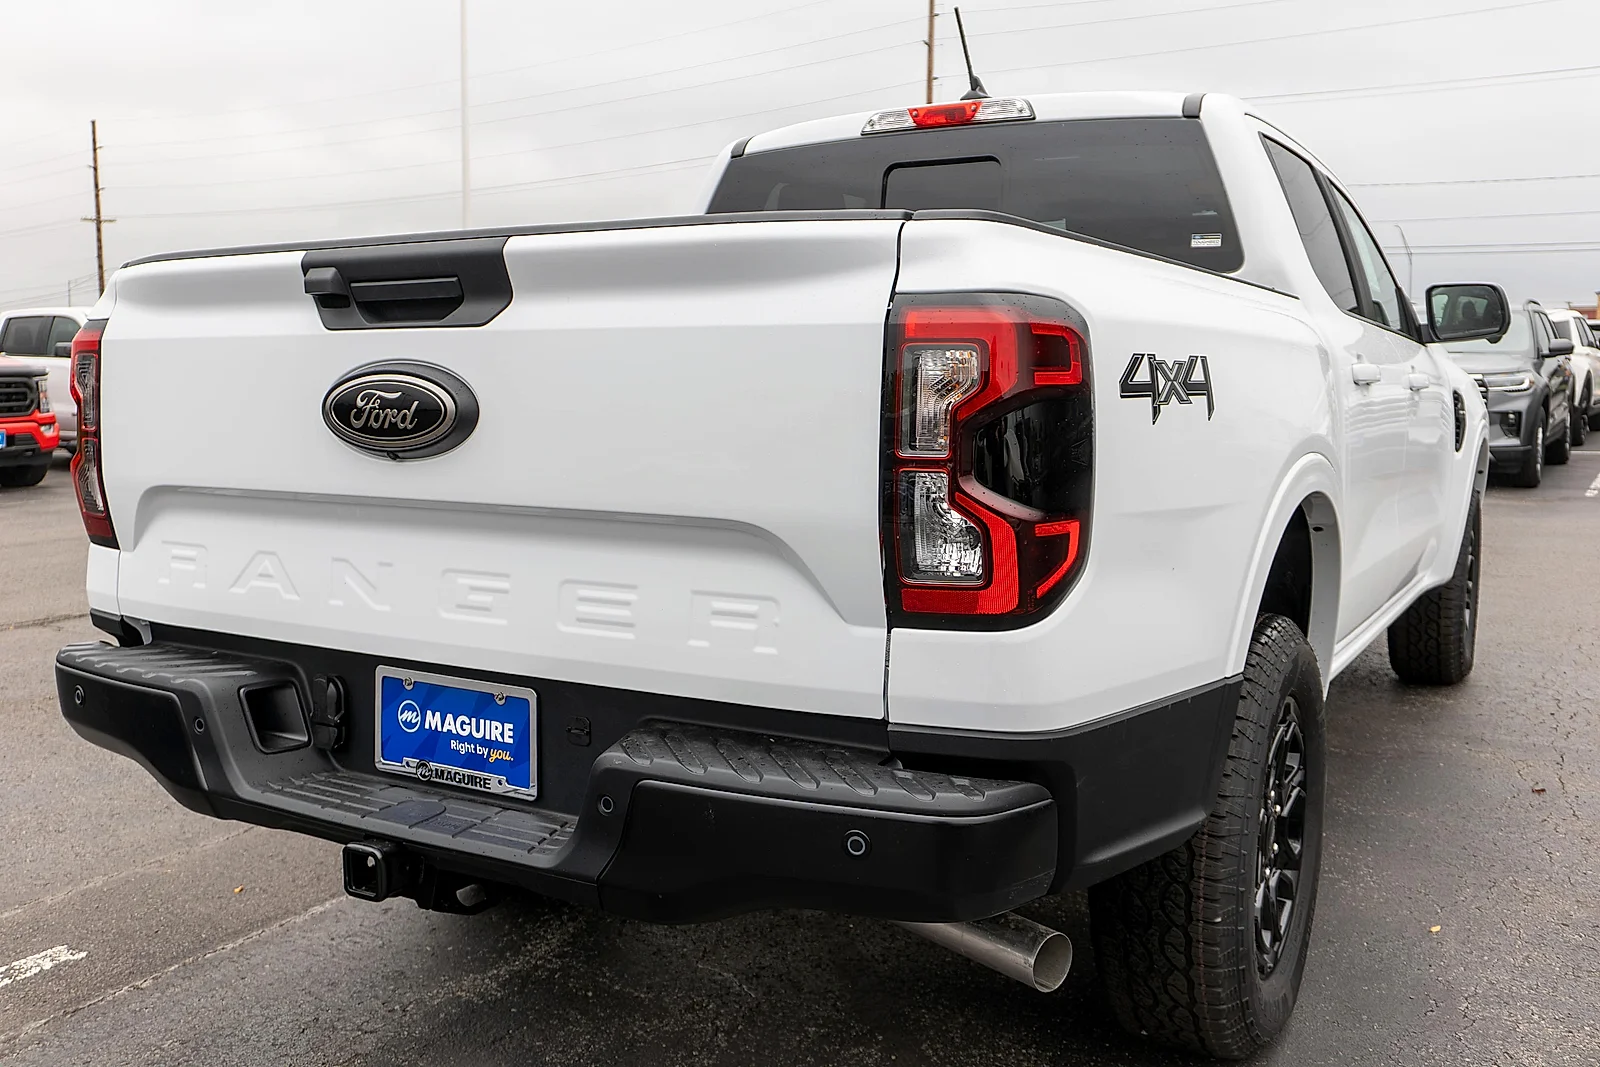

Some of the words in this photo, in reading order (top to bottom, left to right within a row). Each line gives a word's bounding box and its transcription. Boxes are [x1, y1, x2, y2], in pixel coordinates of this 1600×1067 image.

[350, 389, 420, 430] Ford
[156, 539, 782, 656] RANGER
[424, 709, 514, 744] MAGUIRE
[450, 739, 475, 755] Right
[476, 743, 489, 758] by
[489, 749, 514, 763] you.
[433, 768, 492, 790] MAGUIRE
